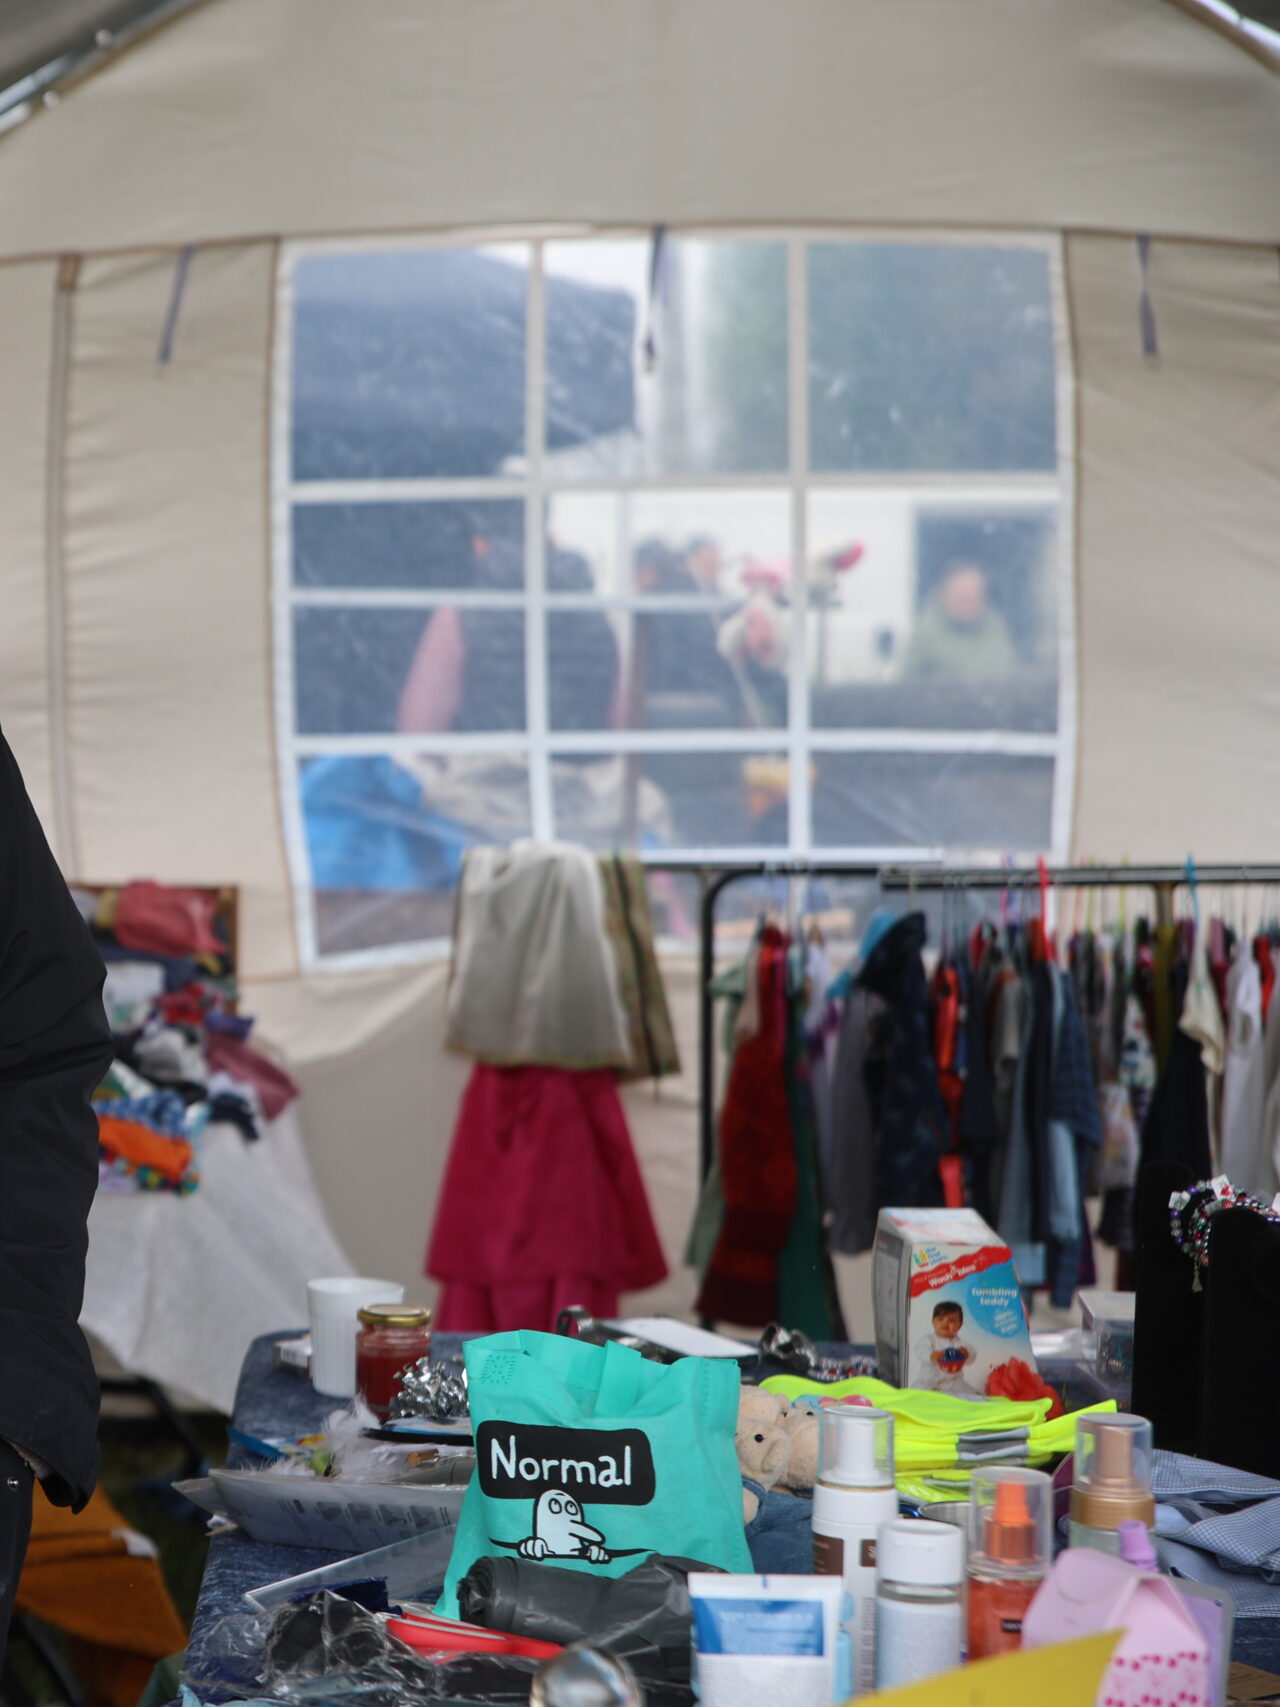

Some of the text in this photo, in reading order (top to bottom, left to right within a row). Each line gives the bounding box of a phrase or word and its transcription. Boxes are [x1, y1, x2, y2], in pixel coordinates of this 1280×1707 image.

[972, 1287, 1017, 1299] tumbling
[980, 1298, 1009, 1307] teddy
[491, 1435, 632, 1488] Normal
